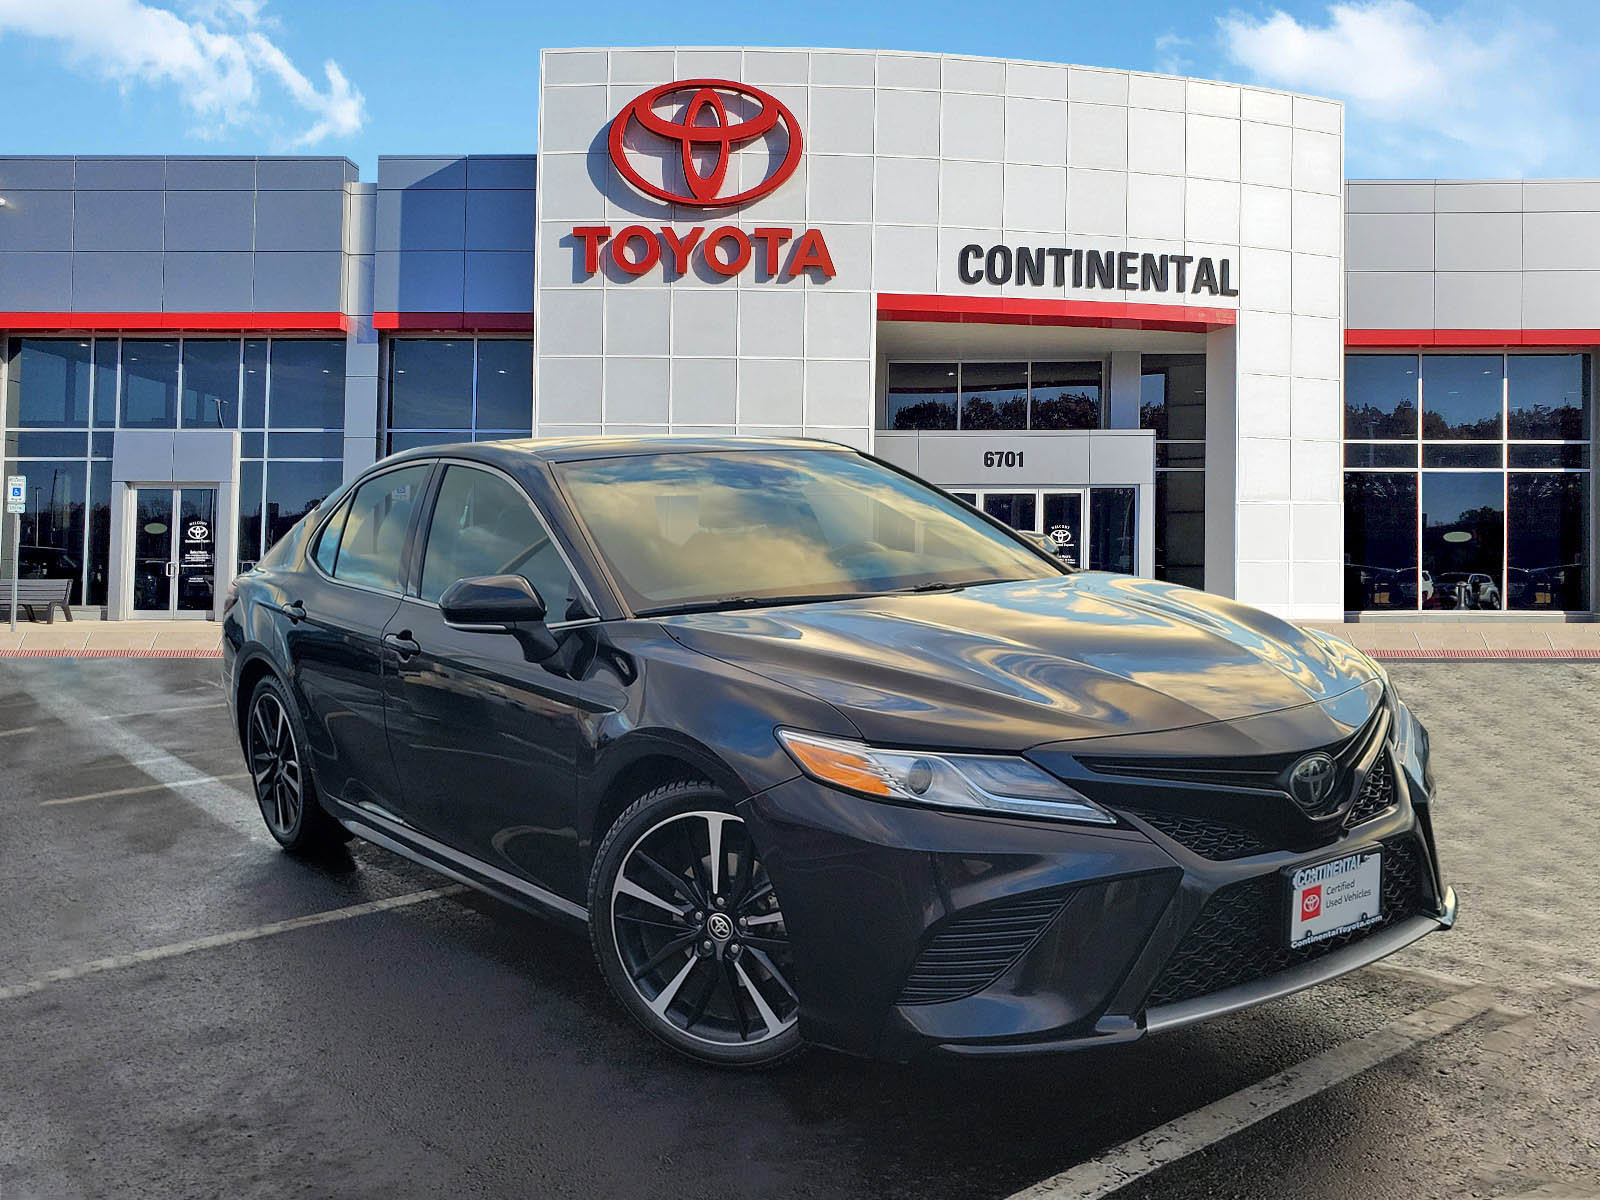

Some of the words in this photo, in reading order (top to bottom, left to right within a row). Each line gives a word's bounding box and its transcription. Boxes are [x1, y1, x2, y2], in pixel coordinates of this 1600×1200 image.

[573, 225, 836, 277] TOYOTA
[958, 244, 1239, 297] CONTINENTAL
[983, 451, 1024, 468] 6701
[1296, 854, 1362, 888] CONTINENTAL
[1326, 880, 1356, 896] Certified
[1326, 897, 1343, 909] Used
[1344, 888, 1372, 903] Vehicles
[1291, 915, 1383, 949] ContinentalToyota.com
